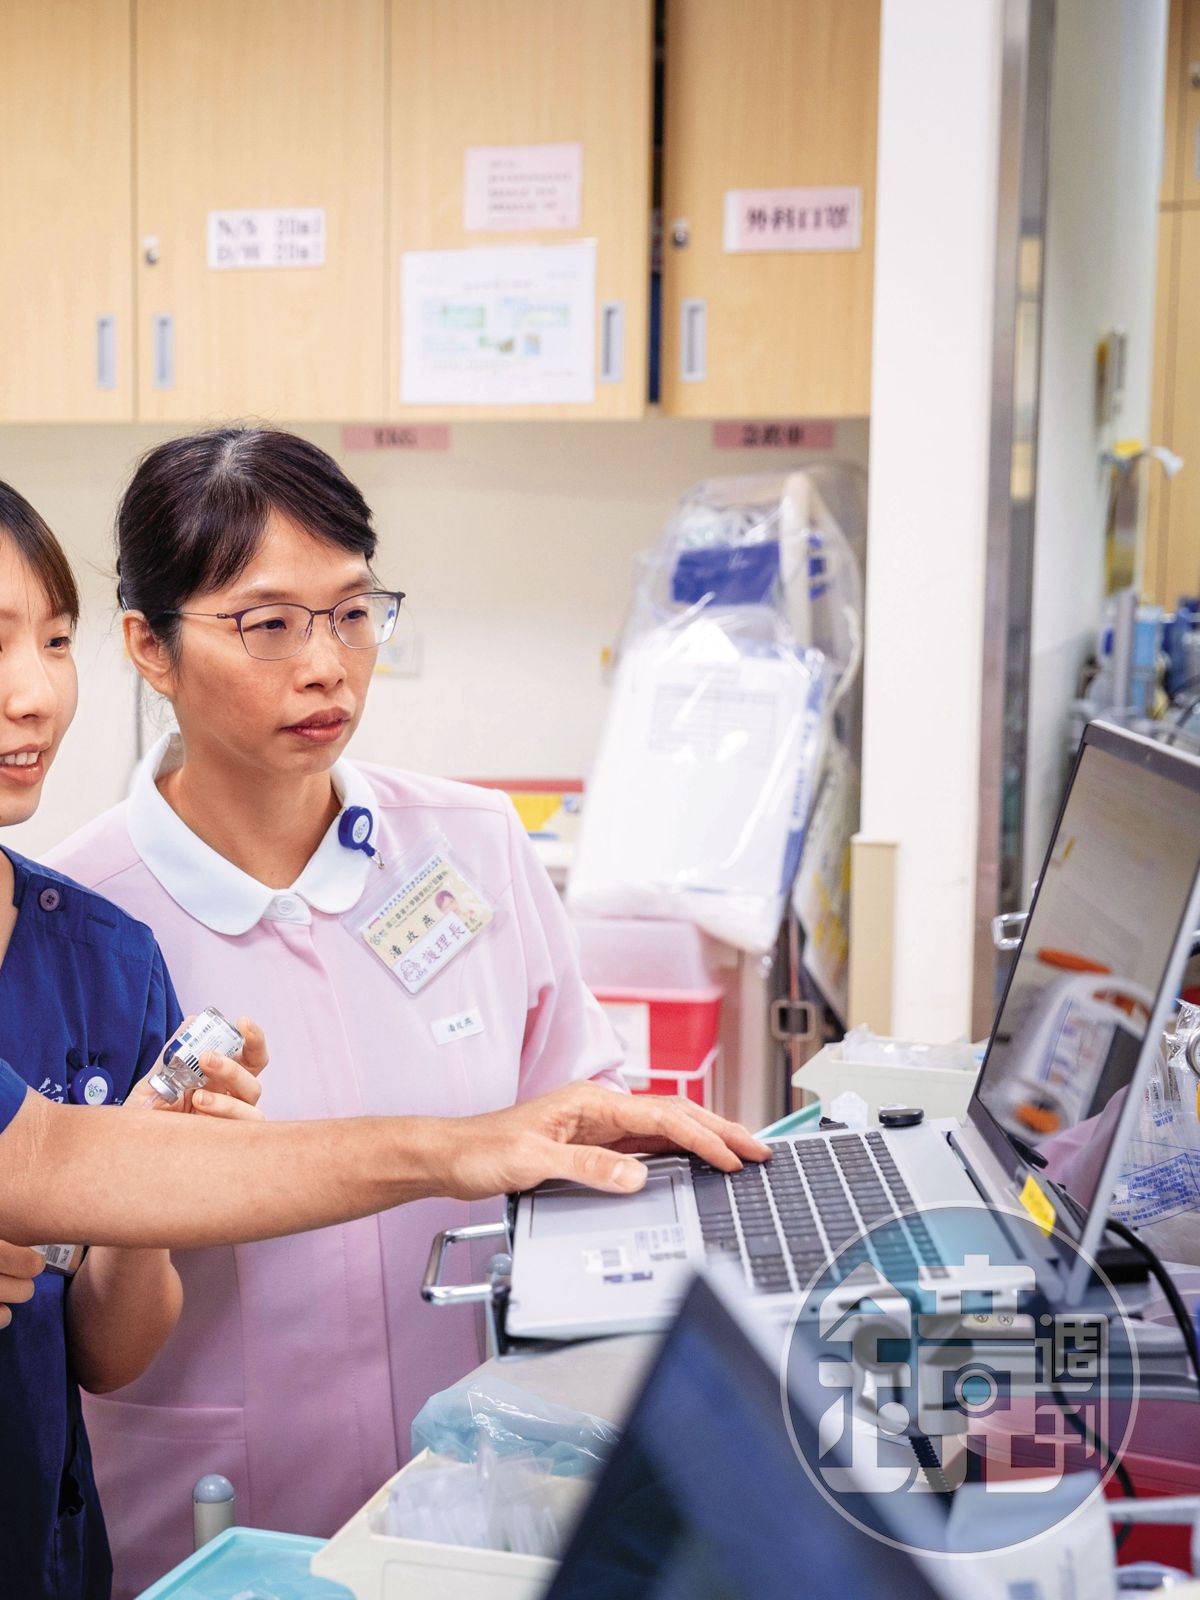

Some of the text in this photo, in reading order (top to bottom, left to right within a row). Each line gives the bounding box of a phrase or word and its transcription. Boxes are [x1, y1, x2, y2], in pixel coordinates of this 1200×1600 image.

[747, 204, 850, 232] 外科口罩
[422, 923, 465, 964] 護理長
